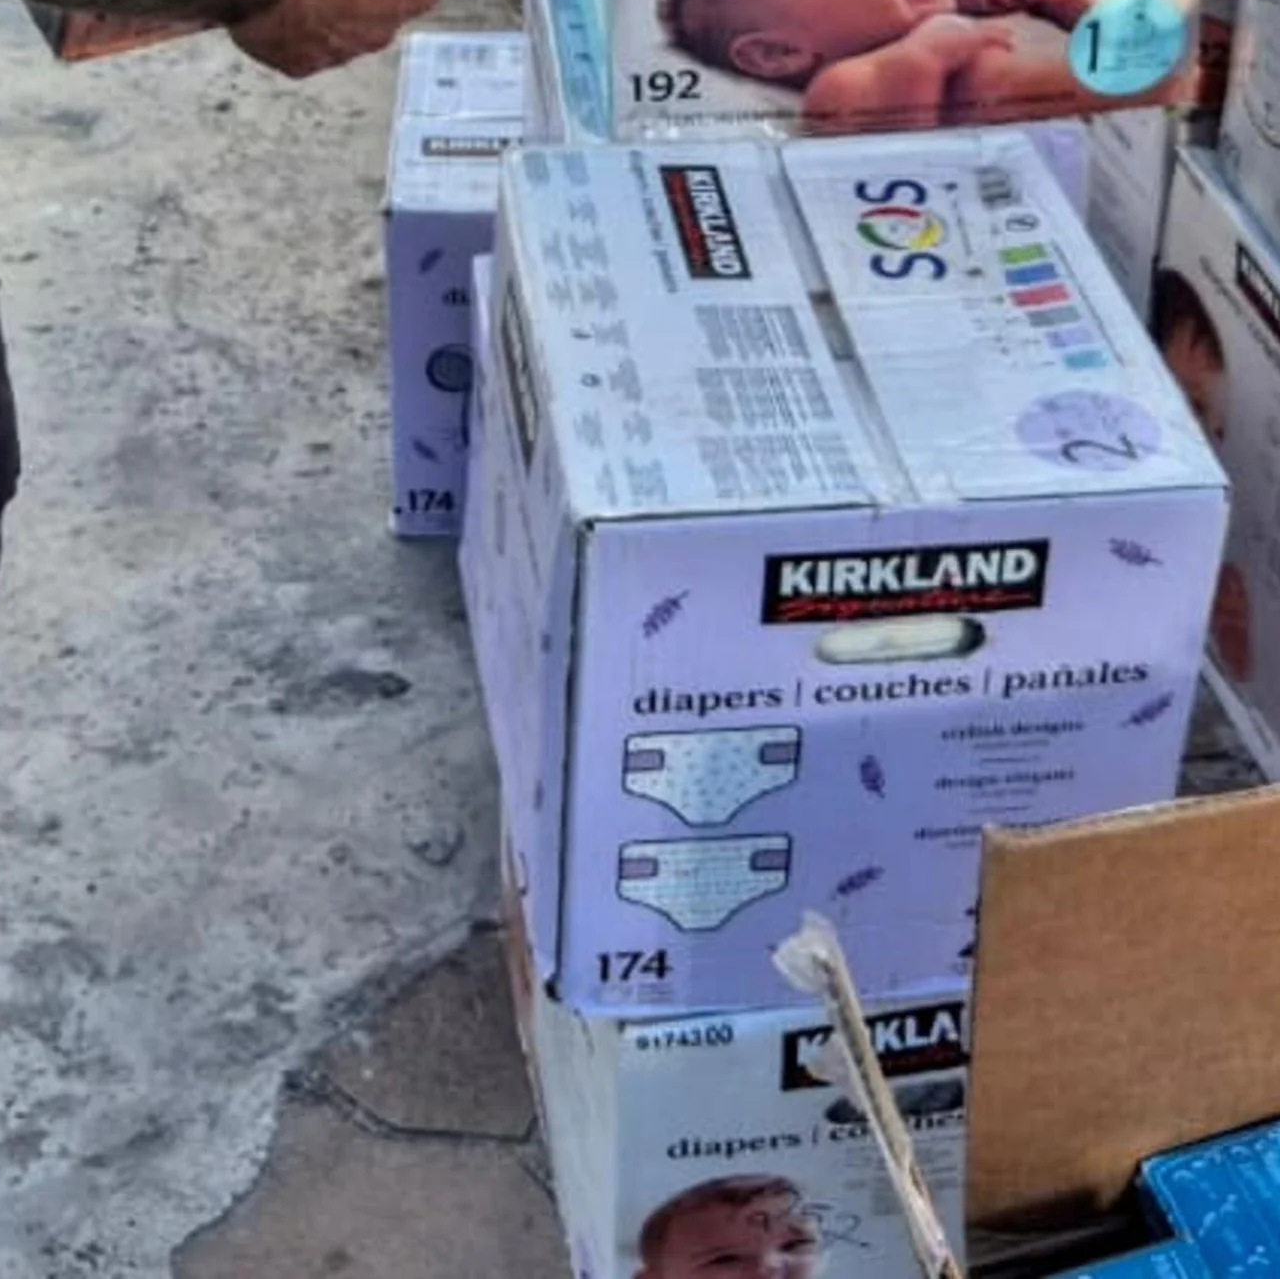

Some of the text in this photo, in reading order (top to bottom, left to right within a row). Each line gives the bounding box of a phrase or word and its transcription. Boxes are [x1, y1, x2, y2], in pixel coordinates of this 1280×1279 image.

[630, 68, 701, 104] 192
[778, 546, 1038, 597] KIRKLAND
[633, 659, 1150, 719] diapers couches pañales
[596, 949, 673, 983] 174
[667, 1126, 802, 1161] diapers
